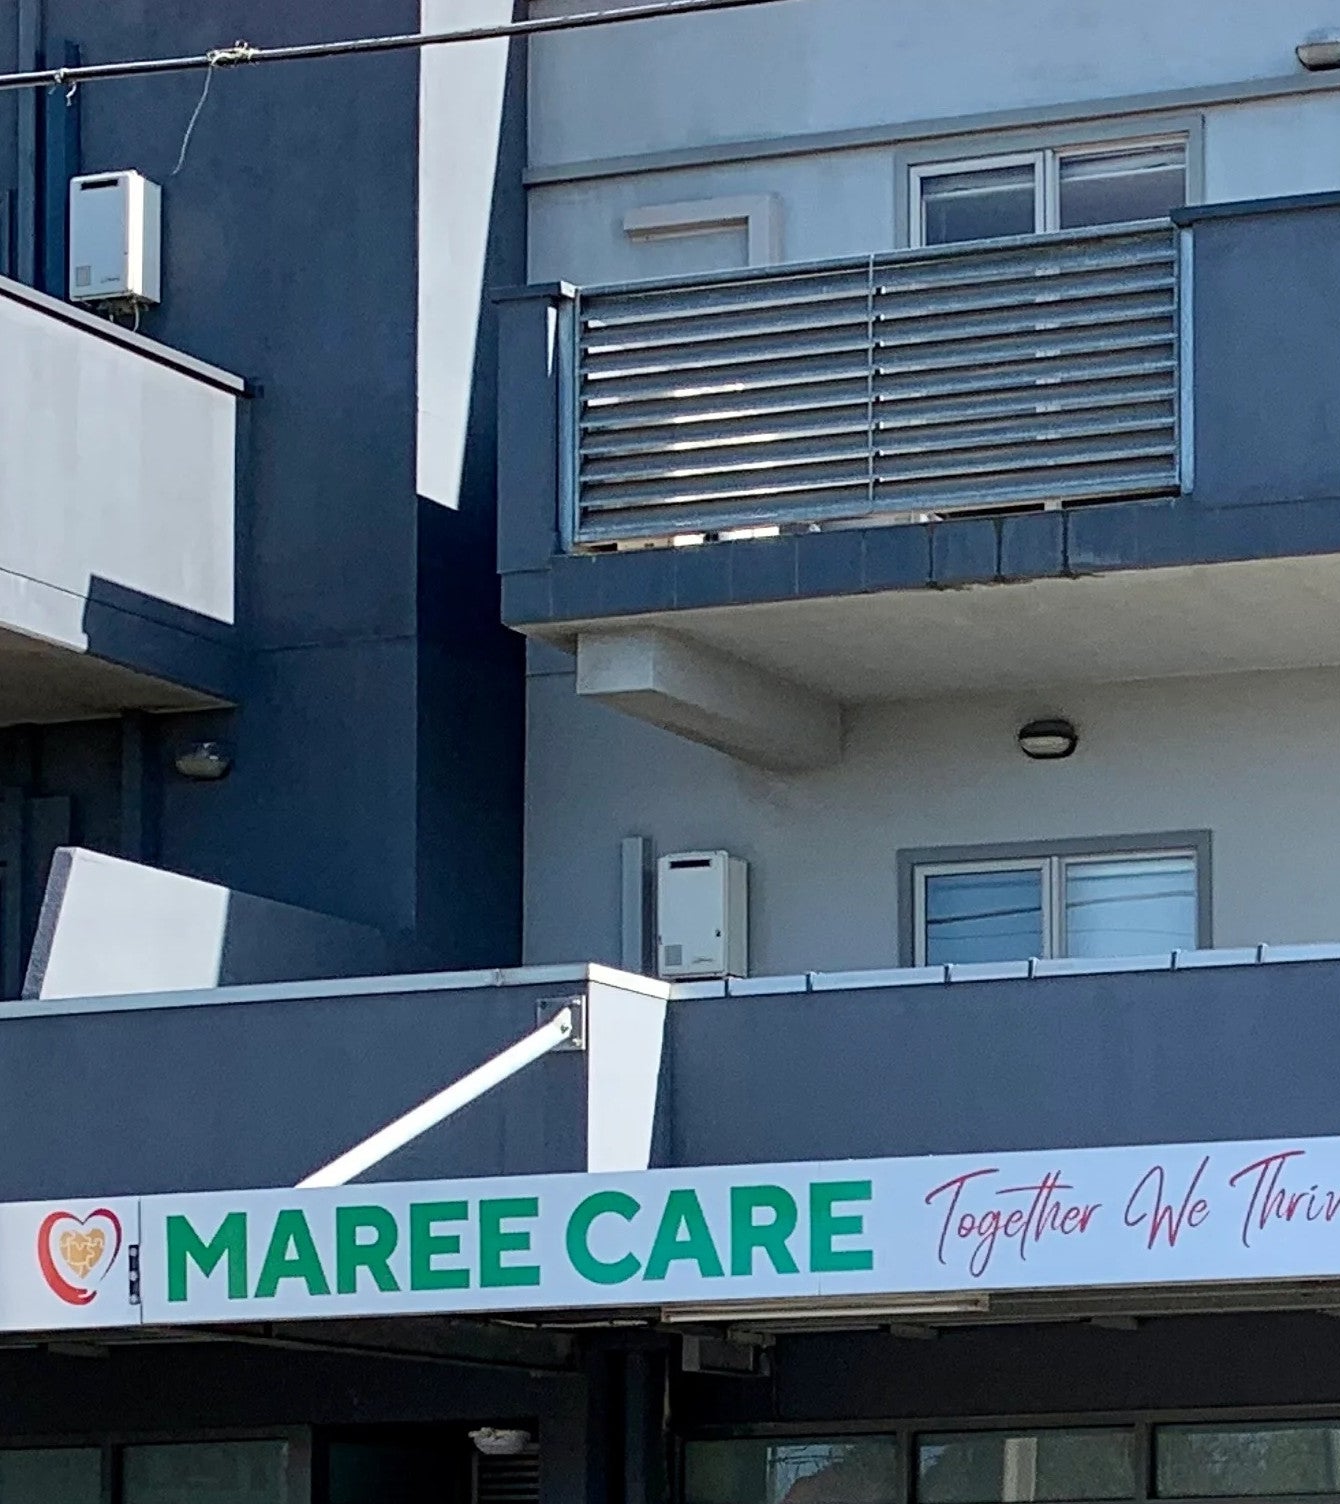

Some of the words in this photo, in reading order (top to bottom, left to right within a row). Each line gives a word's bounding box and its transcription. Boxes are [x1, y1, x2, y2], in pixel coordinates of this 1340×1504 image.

[166, 1195, 540, 1303] MAREE
[565, 1180, 873, 1285] CARE
[925, 1168, 1102, 1277] Together
[1124, 1156, 1210, 1250] We
